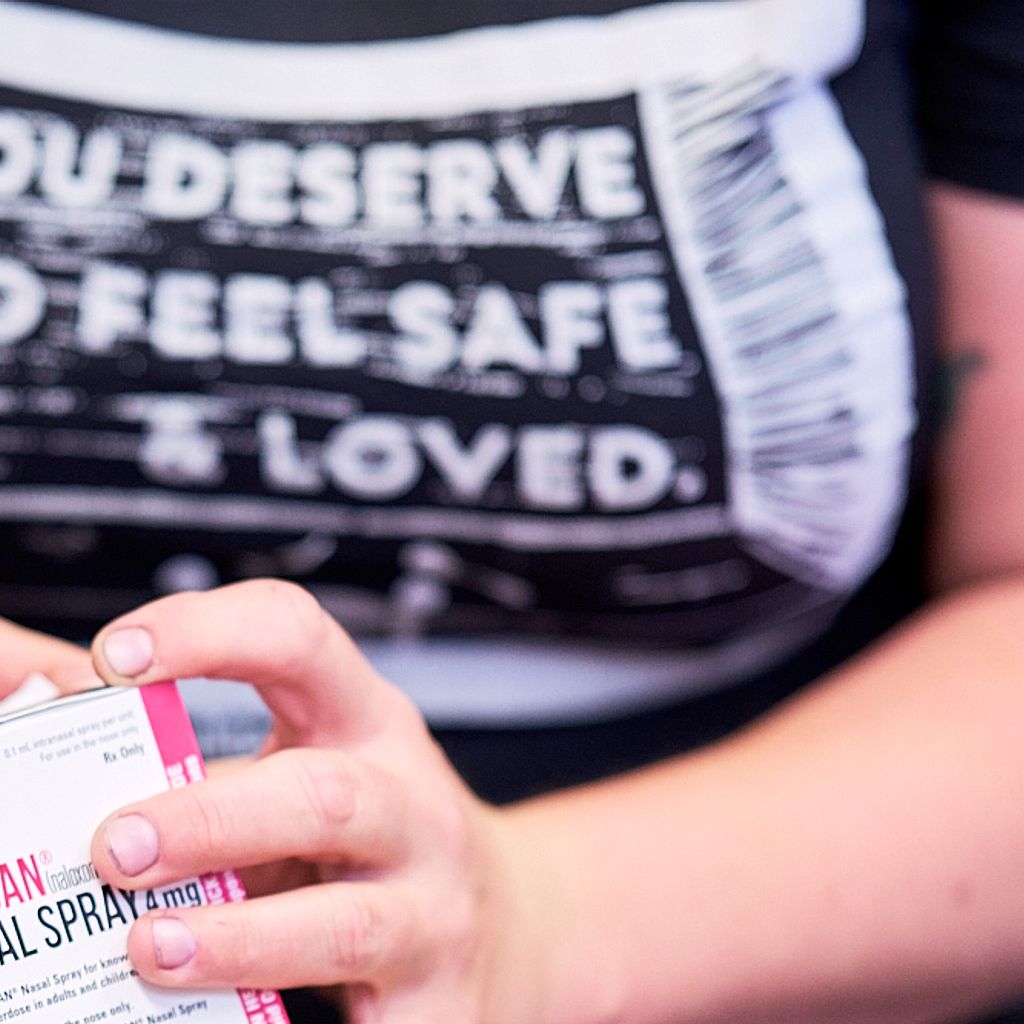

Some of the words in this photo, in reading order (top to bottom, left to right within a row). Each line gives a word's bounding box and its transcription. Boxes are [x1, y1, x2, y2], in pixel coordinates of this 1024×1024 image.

[141, 126, 647, 228] DESERVE
[75, 263, 367, 369] FEEL
[389, 277, 684, 378] SAFE
[256, 408, 707, 511] LOVED.
[33, 728, 75, 749] intranasal
[77, 722, 101, 736] spray
[102, 716, 116, 728] per
[56, 747, 72, 757] use
[82, 737, 97, 748] the
[98, 731, 119, 743] nose
[103, 751, 117, 764] Rx
[119, 743, 145, 760] Only
[45, 861, 99, 895] (naloxon
[36, 882, 140, 951] SPRAY
[162, 882, 202, 909] mg
[21, 978, 52, 997] Nasal
[53, 969, 83, 989] Spray
[83, 963, 98, 976] for
[99, 953, 128, 968] know
[33, 998, 45, 1010] in
[46, 988, 78, 1006] adults
[79, 979, 98, 995] and
[100, 968, 139, 988] childre
[178, 998, 208, 1018] Spray
